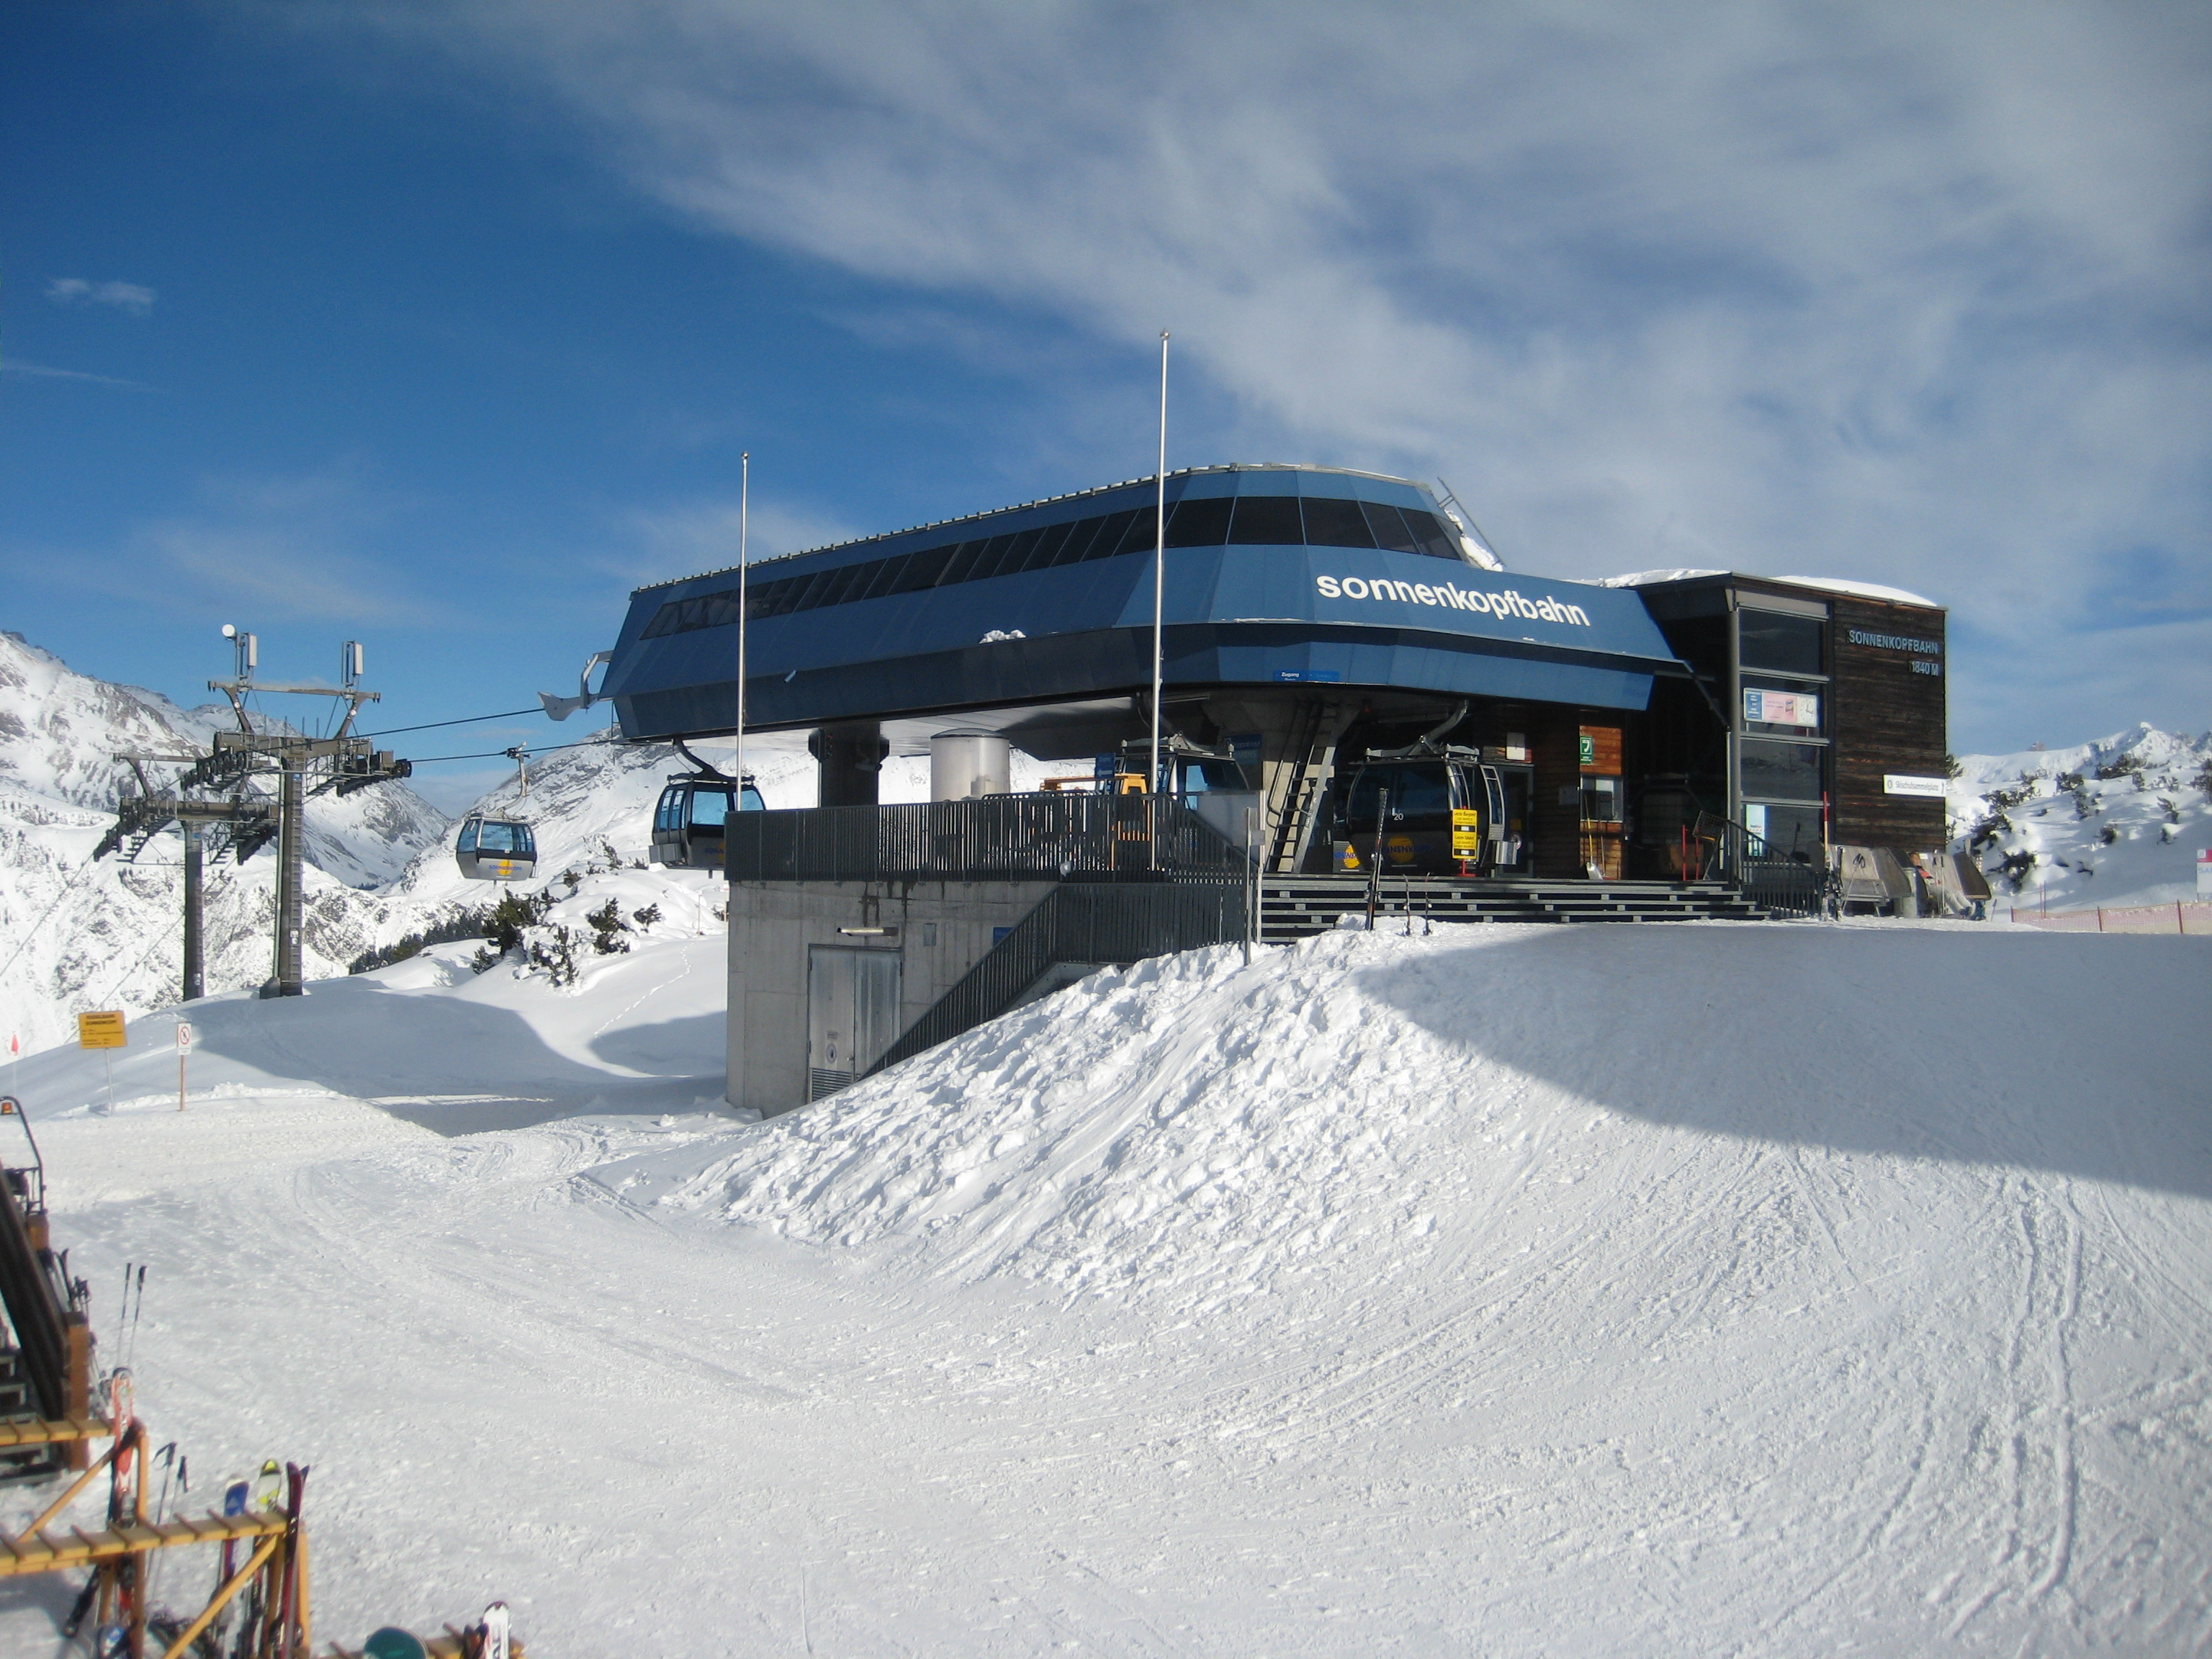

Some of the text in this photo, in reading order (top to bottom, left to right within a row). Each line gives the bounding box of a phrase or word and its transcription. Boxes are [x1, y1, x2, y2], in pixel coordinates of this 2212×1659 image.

[1316, 574, 1591, 626] sonnenkopfbahn
[1848, 629, 1938, 655] SONNENKOPFBAHN
[1911, 660, 1938, 676] 1840 M
